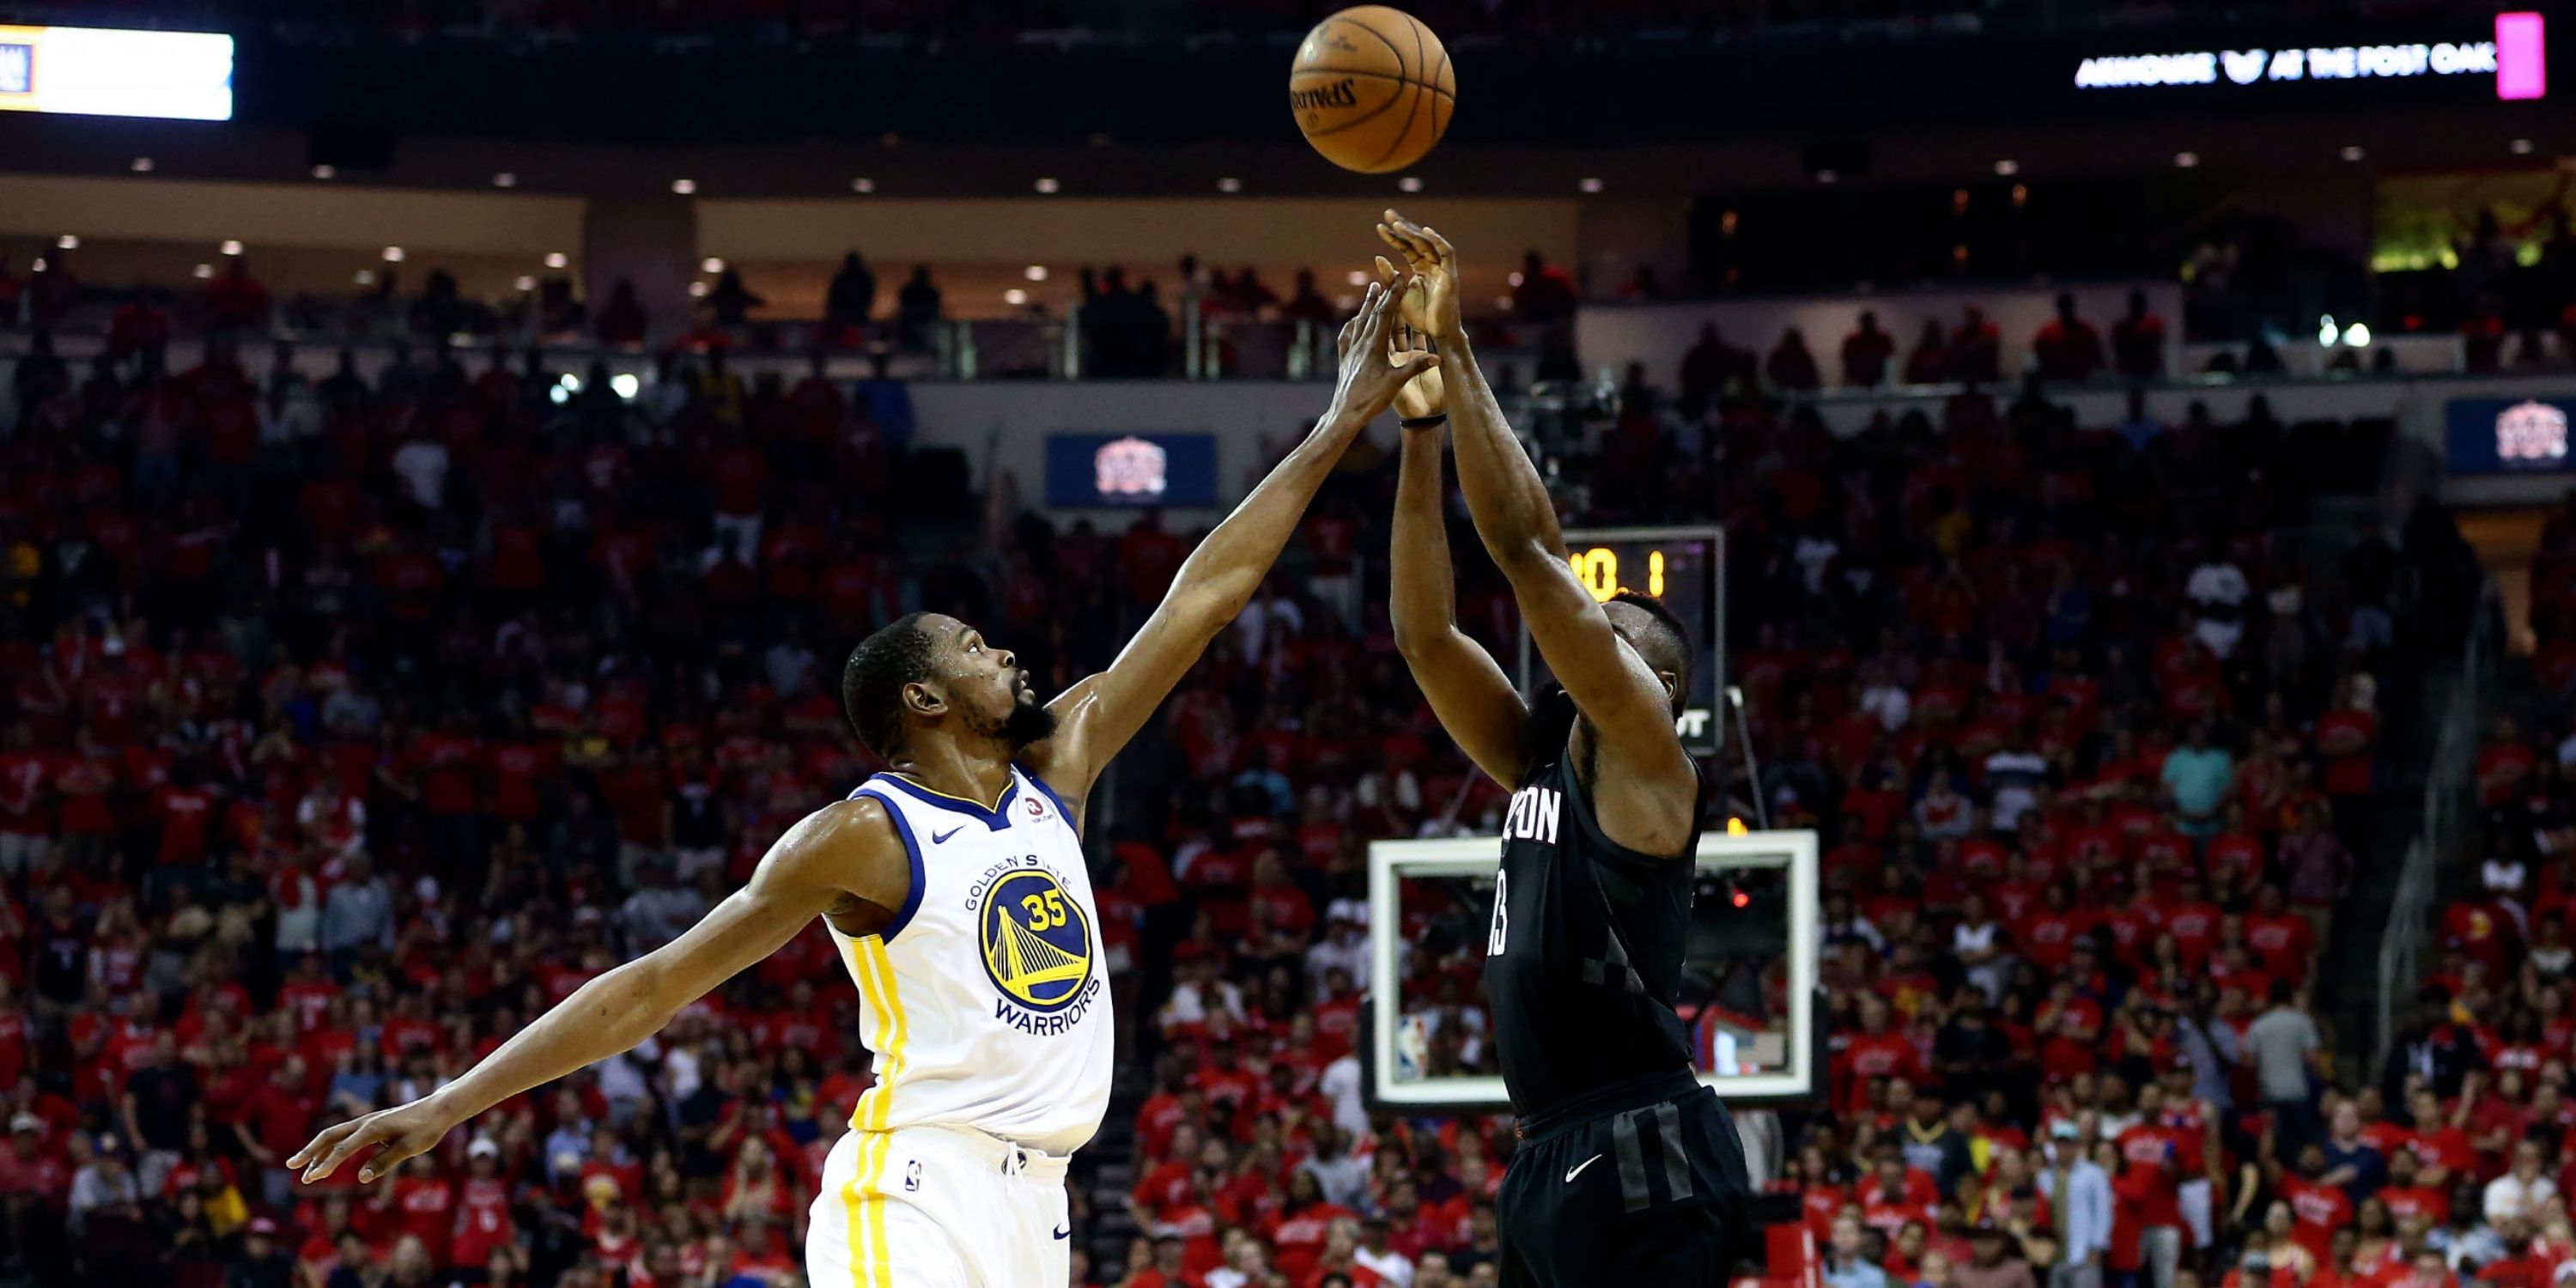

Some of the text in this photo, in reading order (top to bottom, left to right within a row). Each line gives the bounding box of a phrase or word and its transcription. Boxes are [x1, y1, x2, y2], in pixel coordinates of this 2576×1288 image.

[2357, 44, 2429, 77] POST
[2429, 42, 2498, 75] OAK
[965, 855, 1019, 911] GOLDEN
[1021, 889, 1066, 932] 35
[994, 975, 1101, 1036] WARRIORS
